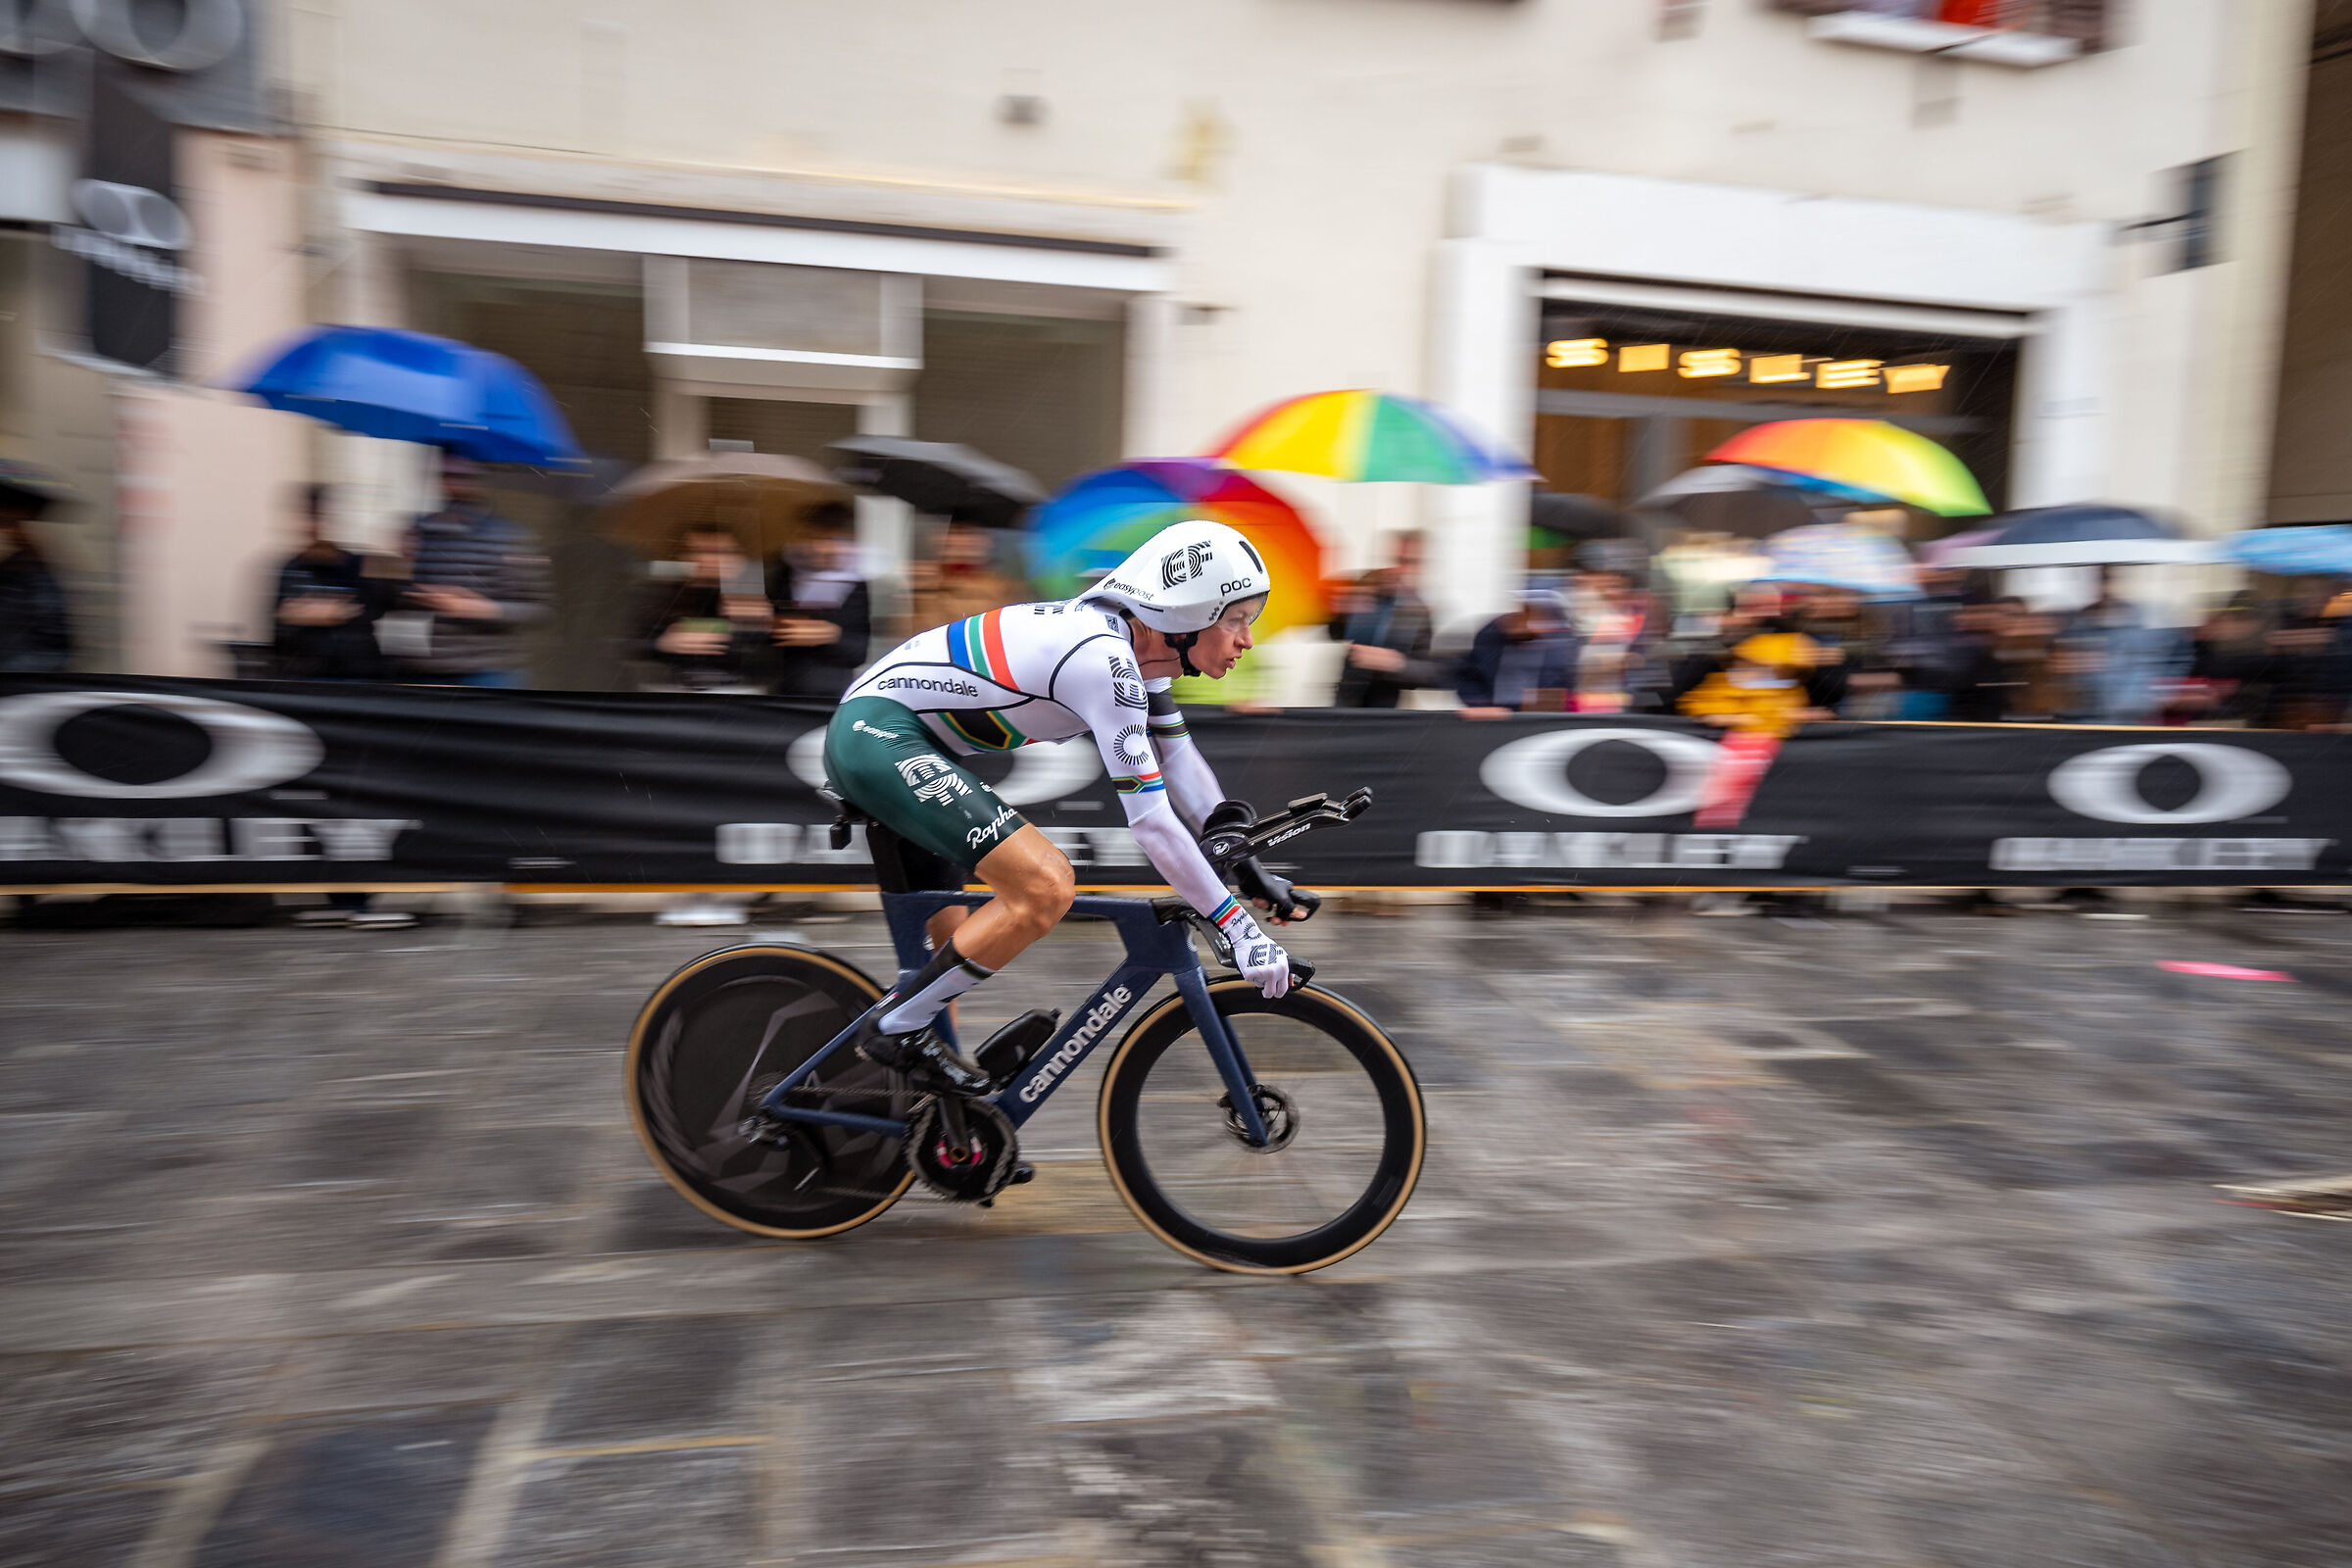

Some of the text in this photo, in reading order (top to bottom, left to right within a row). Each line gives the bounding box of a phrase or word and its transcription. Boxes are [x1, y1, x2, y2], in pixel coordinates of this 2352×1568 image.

[1113, 581, 1154, 602] easypost
[878, 676, 979, 697] cannondale
[966, 806, 1017, 850] Rapha
[1019, 986, 1132, 1103] cannondale
